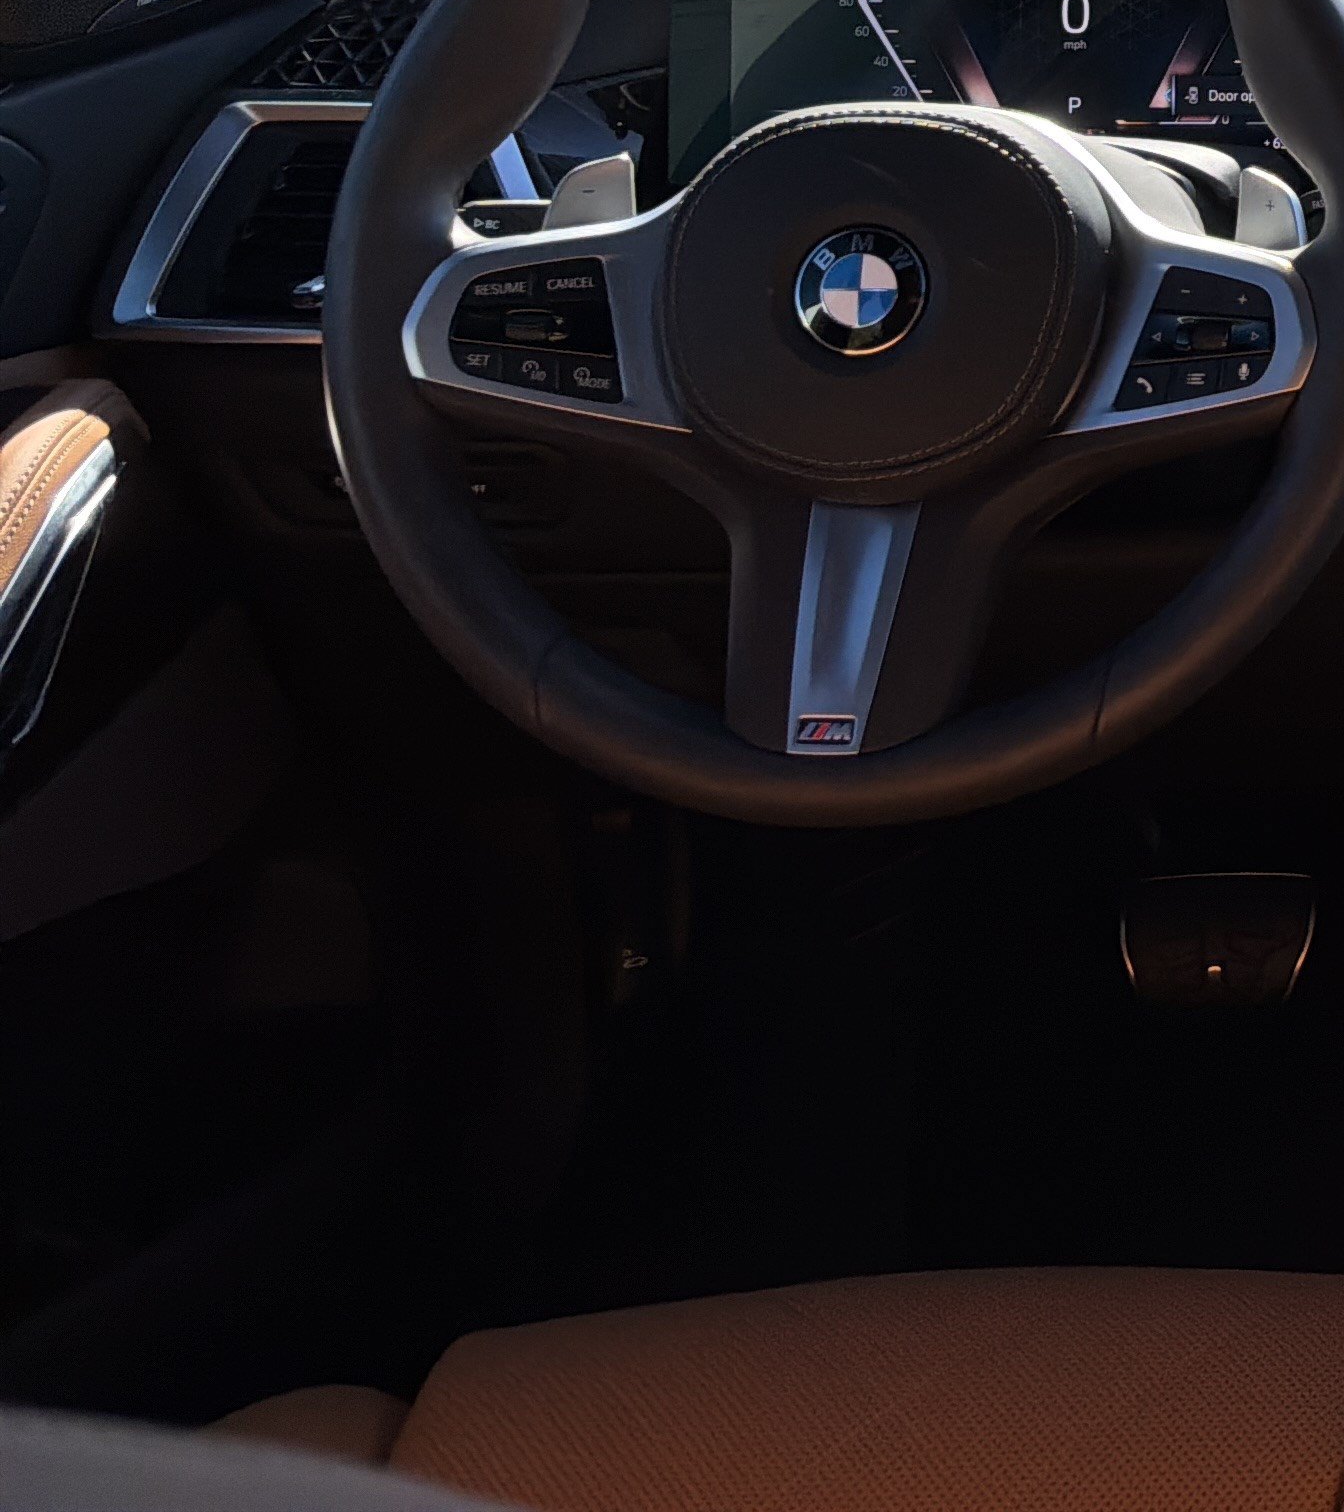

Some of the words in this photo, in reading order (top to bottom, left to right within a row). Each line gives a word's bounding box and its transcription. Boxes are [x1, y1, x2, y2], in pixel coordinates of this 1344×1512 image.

[854, 26, 870, 37] 60
[1063, 40, 1088, 51] mph
[873, 56, 889, 67] 40
[892, 86, 908, 97] 20
[1208, 89, 1237, 102] Door
[1068, 96, 1082, 114] P
[813, 233, 915, 271] BMW
[474, 281, 528, 297] RESUME
[546, 276, 595, 291] CANCEL
[466, 353, 491, 367] SET
[578, 377, 612, 390] MODE
